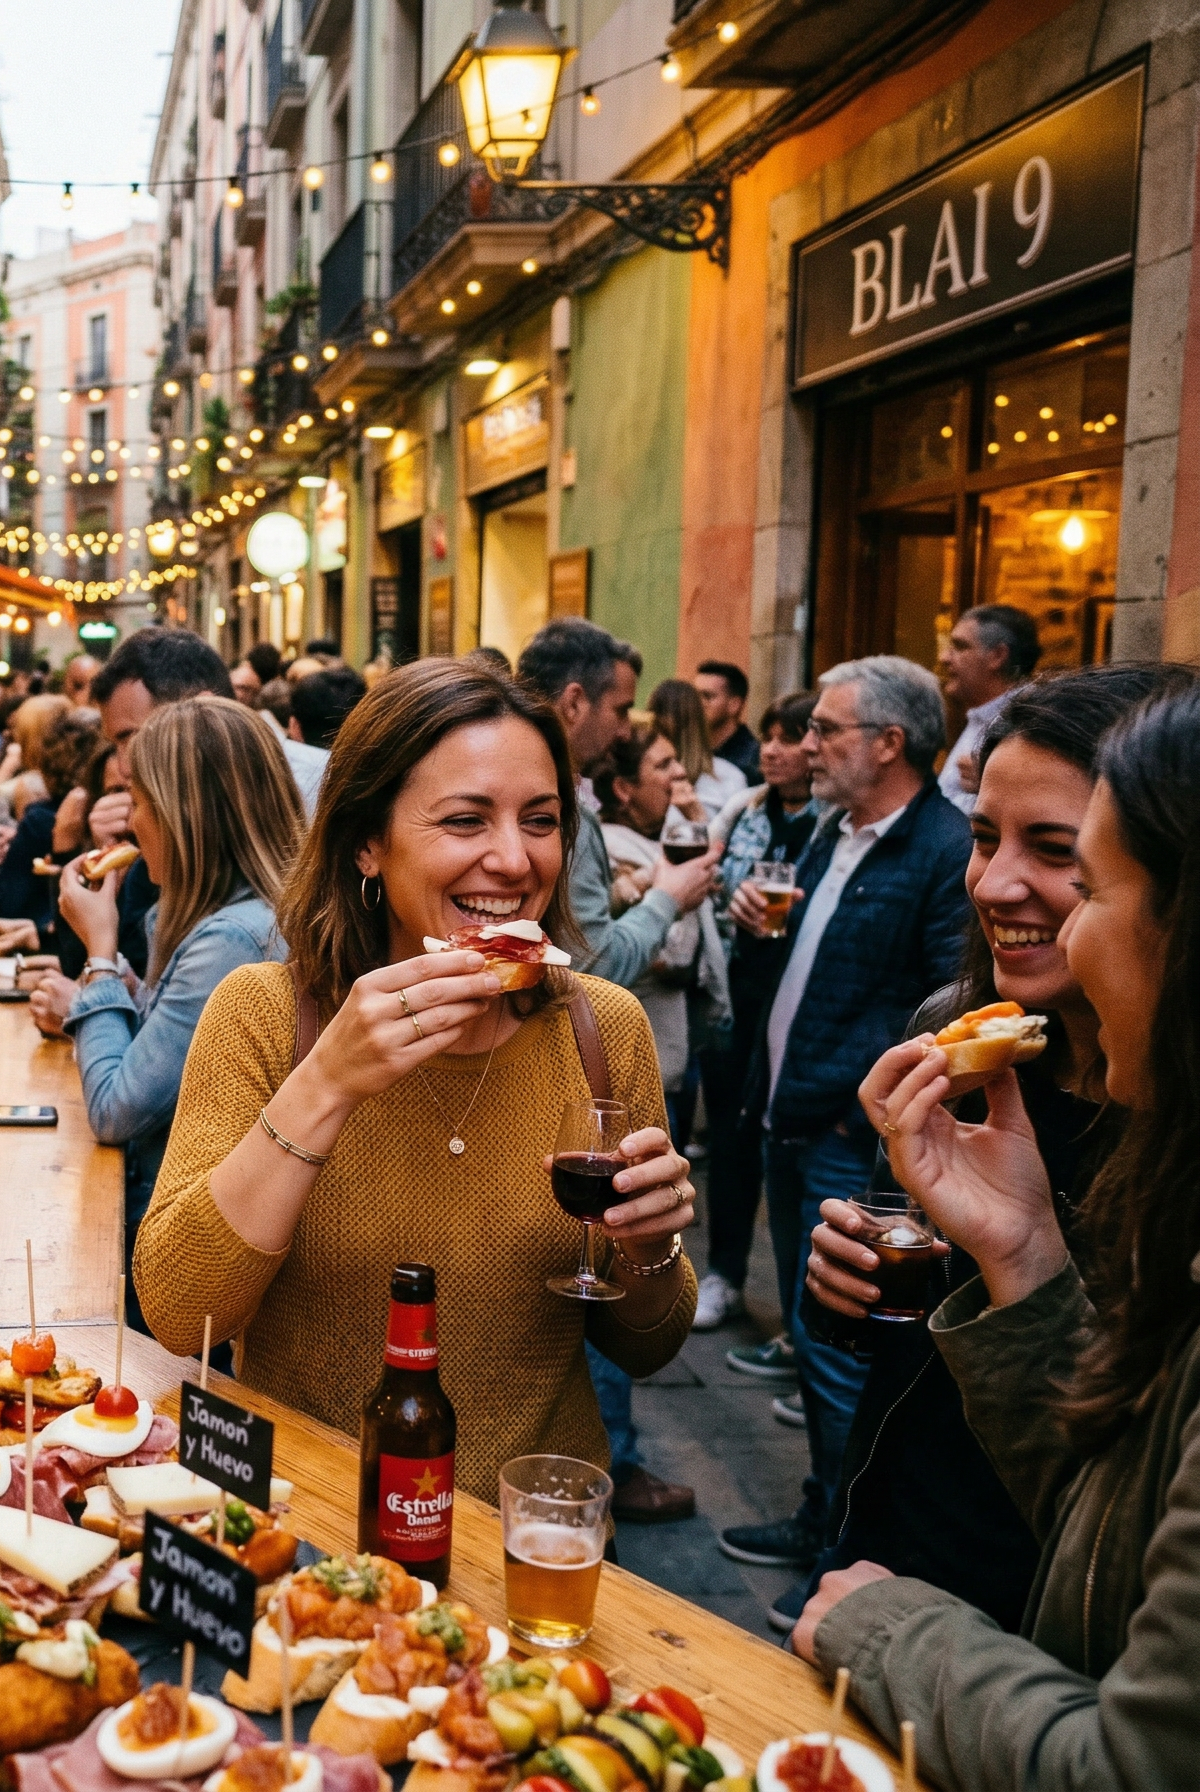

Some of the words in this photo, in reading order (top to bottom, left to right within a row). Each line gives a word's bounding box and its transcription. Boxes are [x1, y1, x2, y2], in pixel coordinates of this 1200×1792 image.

[849, 181, 993, 337] BLAI
[1013, 155, 1054, 269] 9
[201, 1434, 254, 1482] Huevo
[172, 1582, 246, 1658] Huevo
